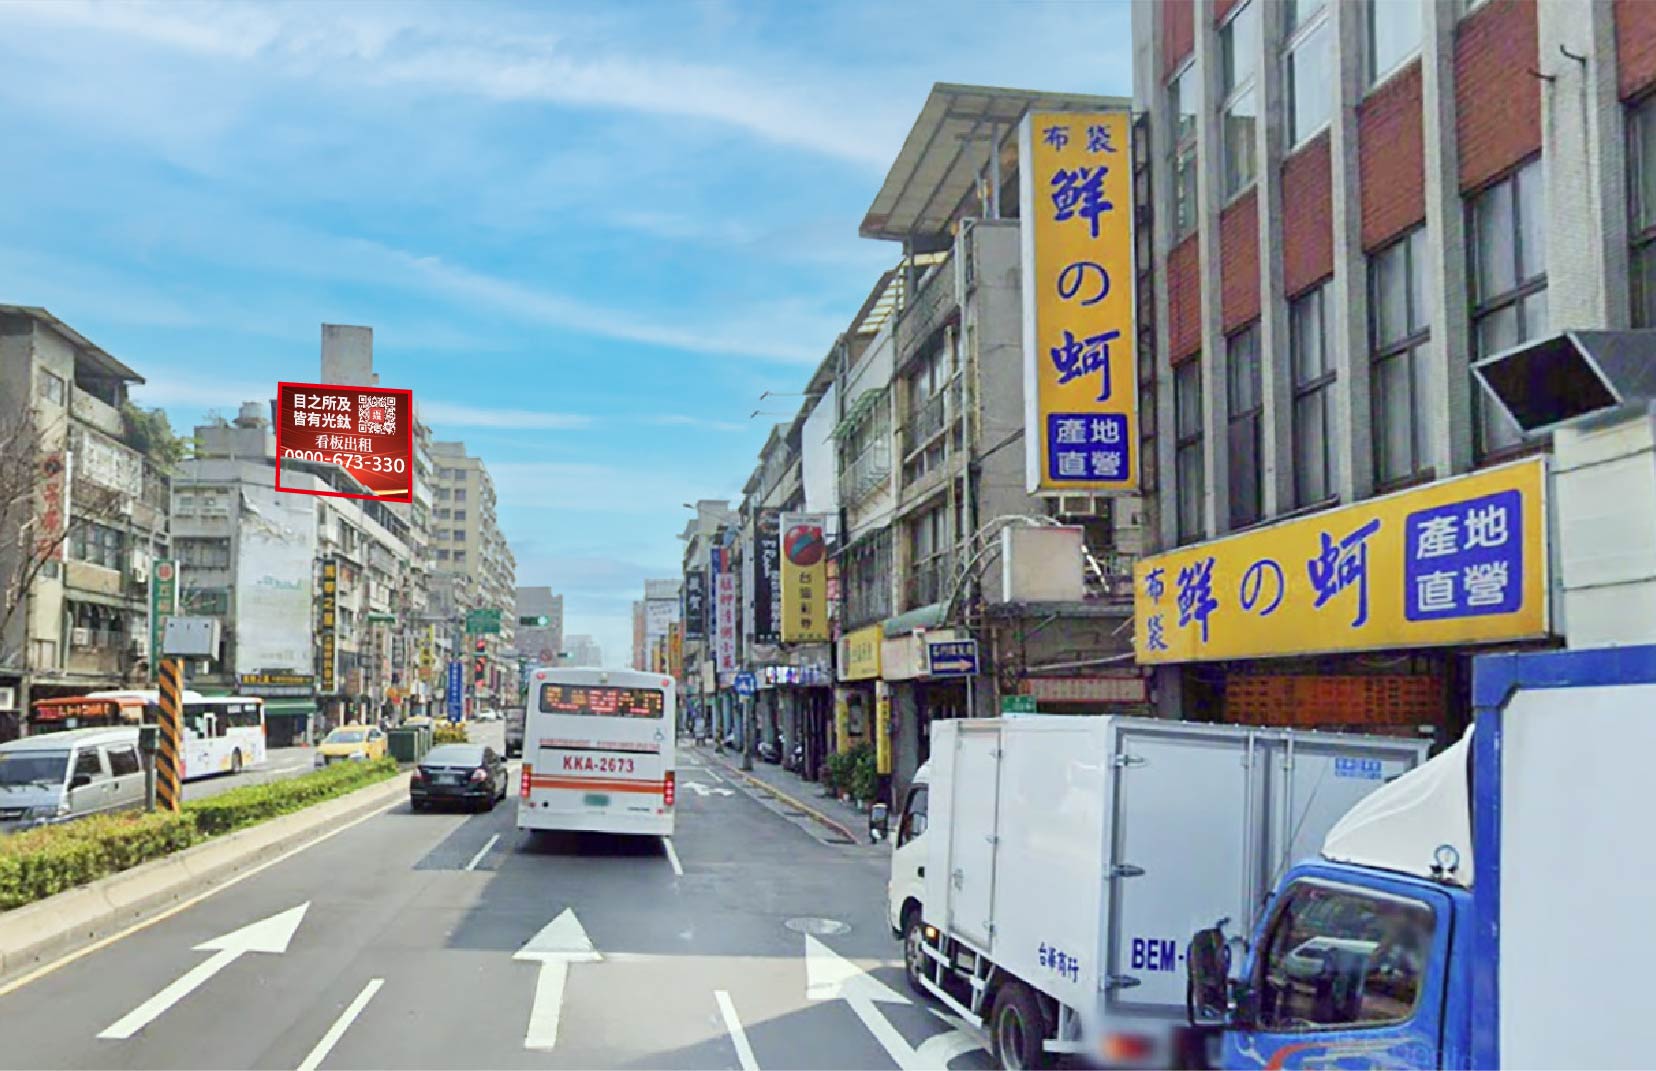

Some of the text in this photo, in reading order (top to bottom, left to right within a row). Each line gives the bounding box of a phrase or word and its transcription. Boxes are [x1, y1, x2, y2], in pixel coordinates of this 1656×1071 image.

[1043, 124, 1117, 153] 布袋
[1050, 166, 1121, 403] 鮮の蚵
[293, 393, 351, 412] 目之所及
[293, 410, 352, 429] 皆有光鈦
[1056, 417, 1121, 444] 產地
[315, 434, 373, 453] 看板出租
[285, 449, 405, 473] 0900-673-330
[1058, 451, 1121, 476] 直營
[1416, 504, 1508, 560] 產地
[1176, 518, 1381, 643] 鮮の蚵
[1416, 561, 1508, 612] 直營
[1144, 567, 1168, 652] 布袋
[563, 756, 634, 773] KKA-2673
